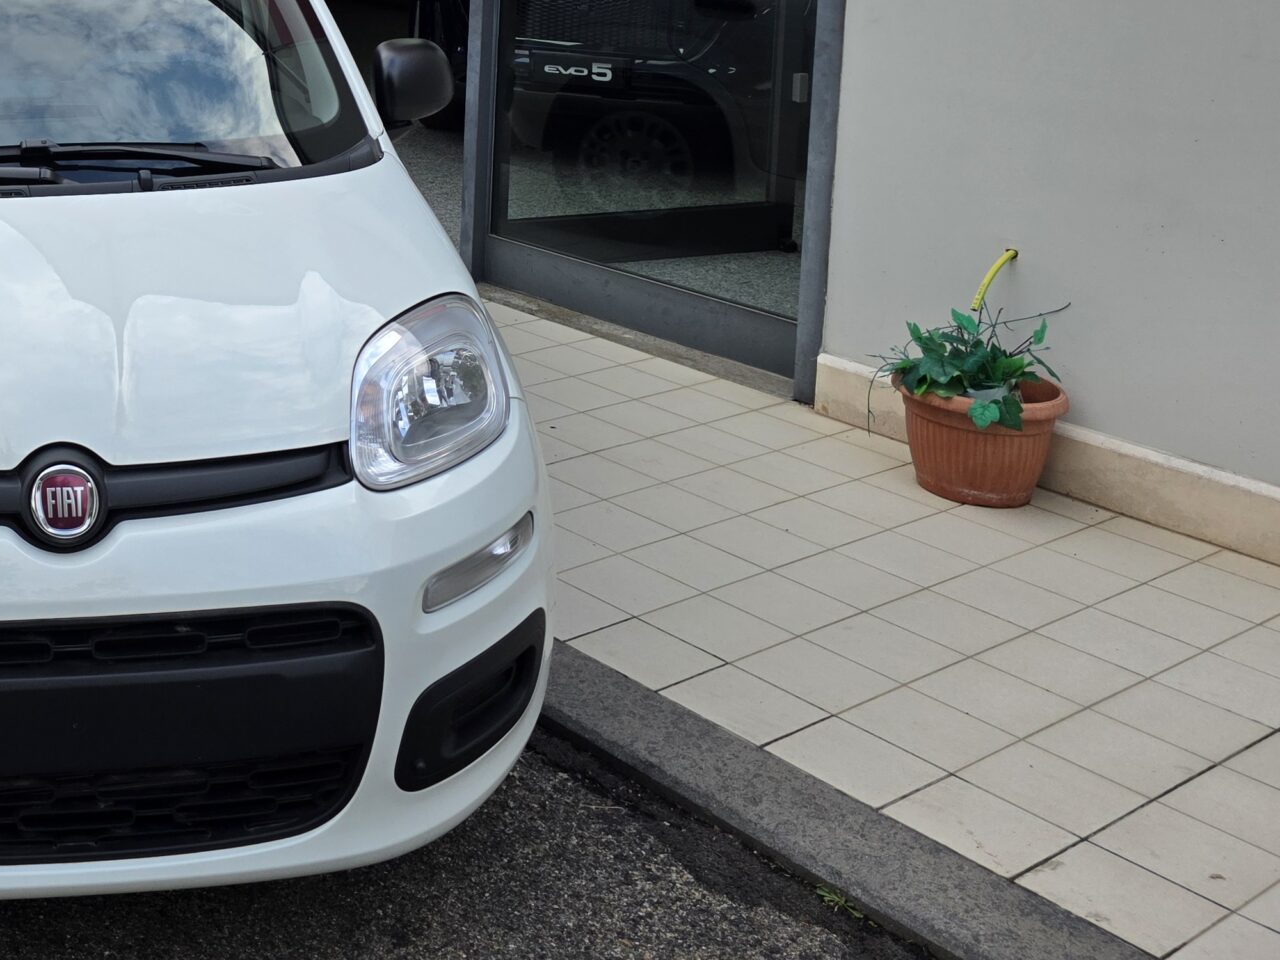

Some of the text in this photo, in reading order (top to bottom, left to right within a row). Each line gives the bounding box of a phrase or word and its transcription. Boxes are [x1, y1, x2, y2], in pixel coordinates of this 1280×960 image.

[544, 62, 613, 82] EVO 5
[46, 486, 84, 519] FIAT
